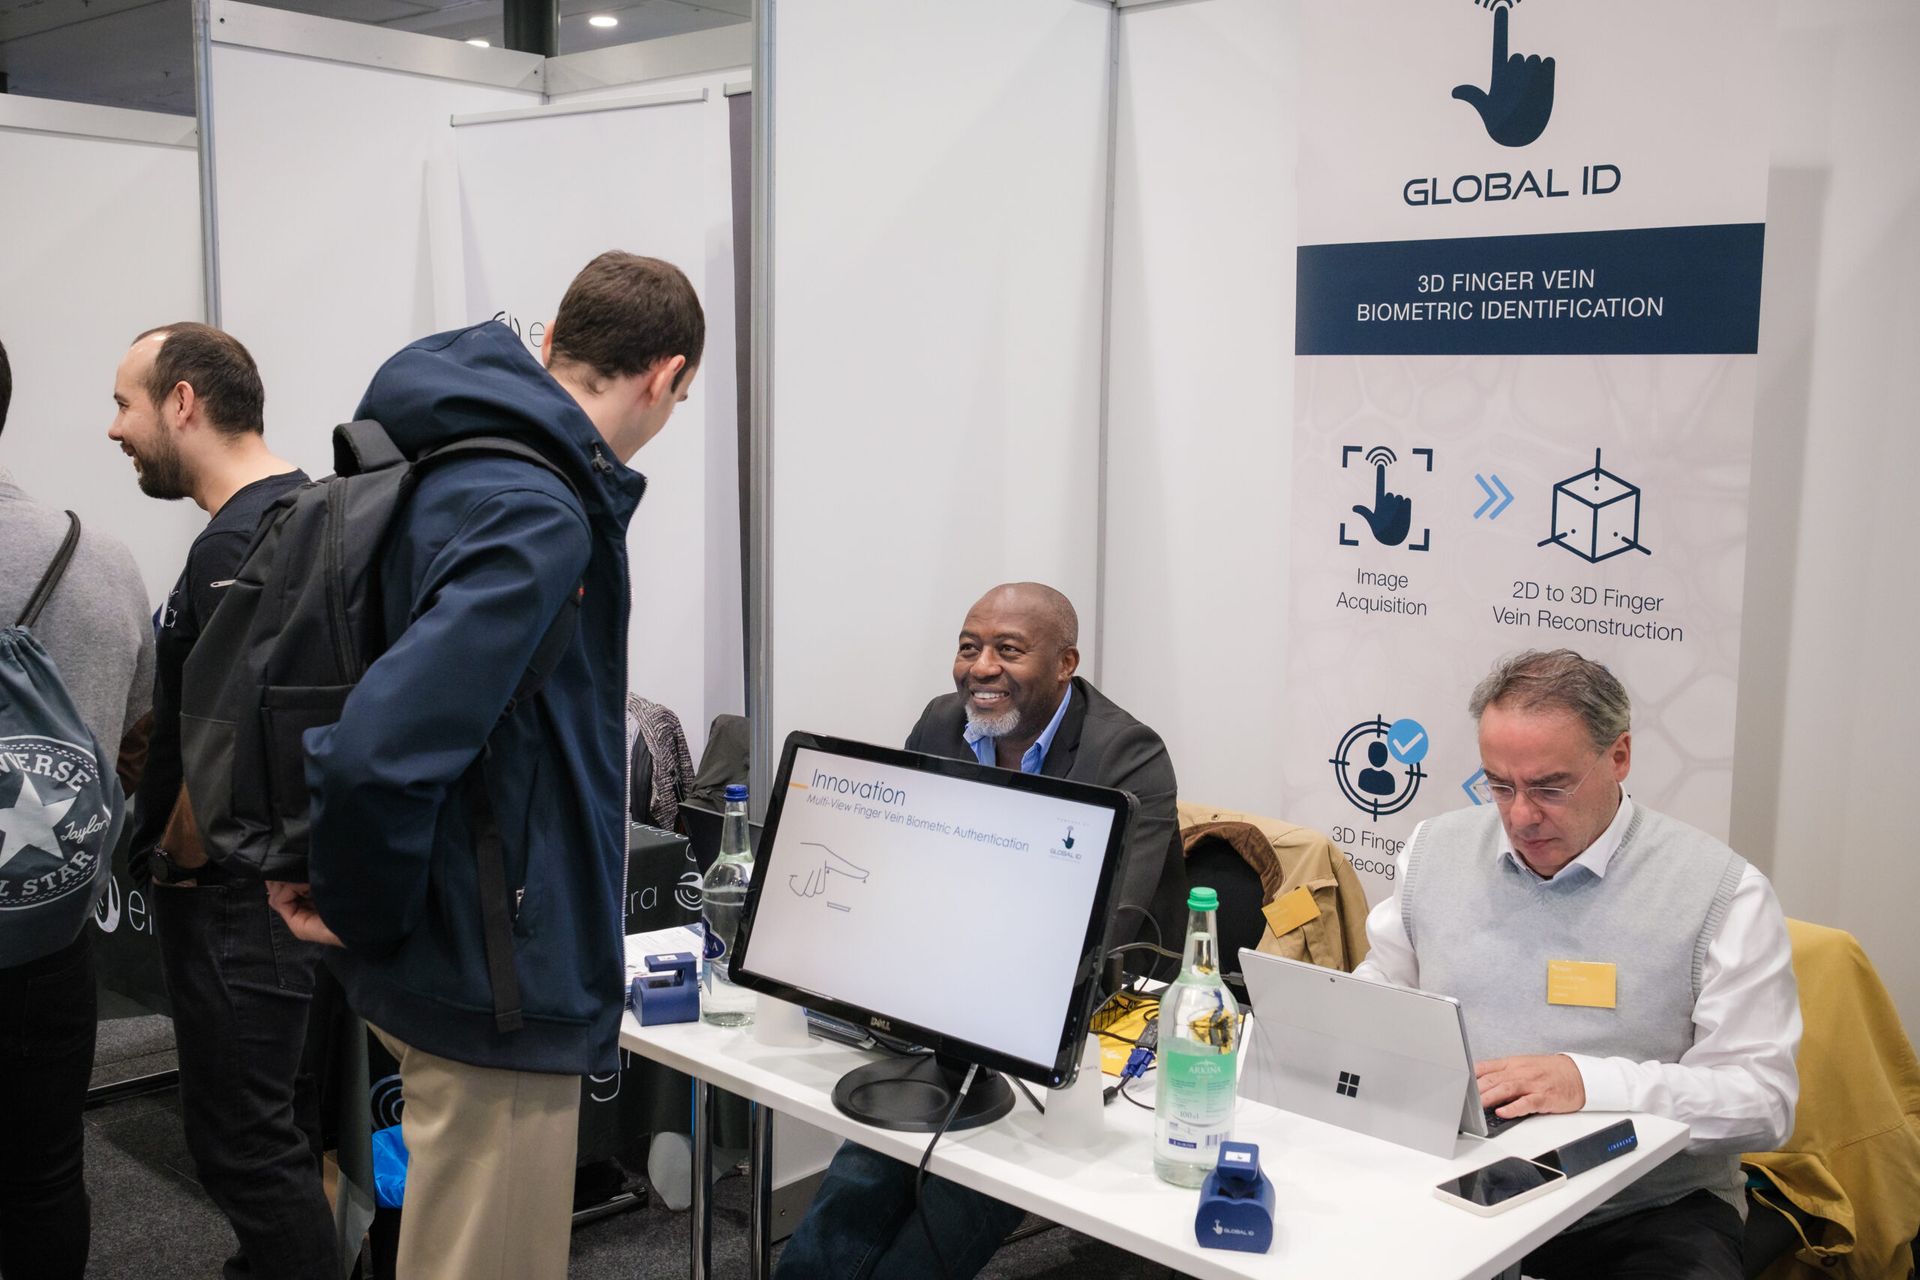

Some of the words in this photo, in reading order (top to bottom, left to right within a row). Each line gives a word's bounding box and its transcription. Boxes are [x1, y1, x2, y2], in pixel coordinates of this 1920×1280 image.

[1403, 168, 1569, 206] GLOBAL
[1582, 164, 1622, 195] ID
[1417, 274, 1445, 293] 3D
[1452, 271, 1534, 292] FINGER
[1542, 269, 1595, 289] VEIN
[1357, 302, 1473, 321] BIOMETRIC
[1481, 297, 1664, 320] IDENTIFICATION
[1356, 568, 1409, 591] Image
[1336, 591, 1428, 616] Acquisition
[1512, 581, 1540, 600] 2D
[1545, 585, 1565, 602] to
[1570, 585, 1598, 605] 3D
[1603, 588, 1664, 614] Finger
[1492, 605, 1531, 626] Vein
[1537, 610, 1684, 642] Reconstruction
[811, 768, 906, 806] Innovation
[60, 814, 109, 844] Taylor
[806, 794, 852, 811] Multi-View
[853, 803, 881, 820] Finger
[884, 809, 905, 825] Vein
[906, 814, 952, 836] Biometric
[953, 826, 1030, 852] Authentication
[1332, 826, 1356, 844] 3D
[1361, 830, 1406, 856] Finge
[22, 850, 94, 896] STAR
[870, 1016, 891, 1031] DELL
